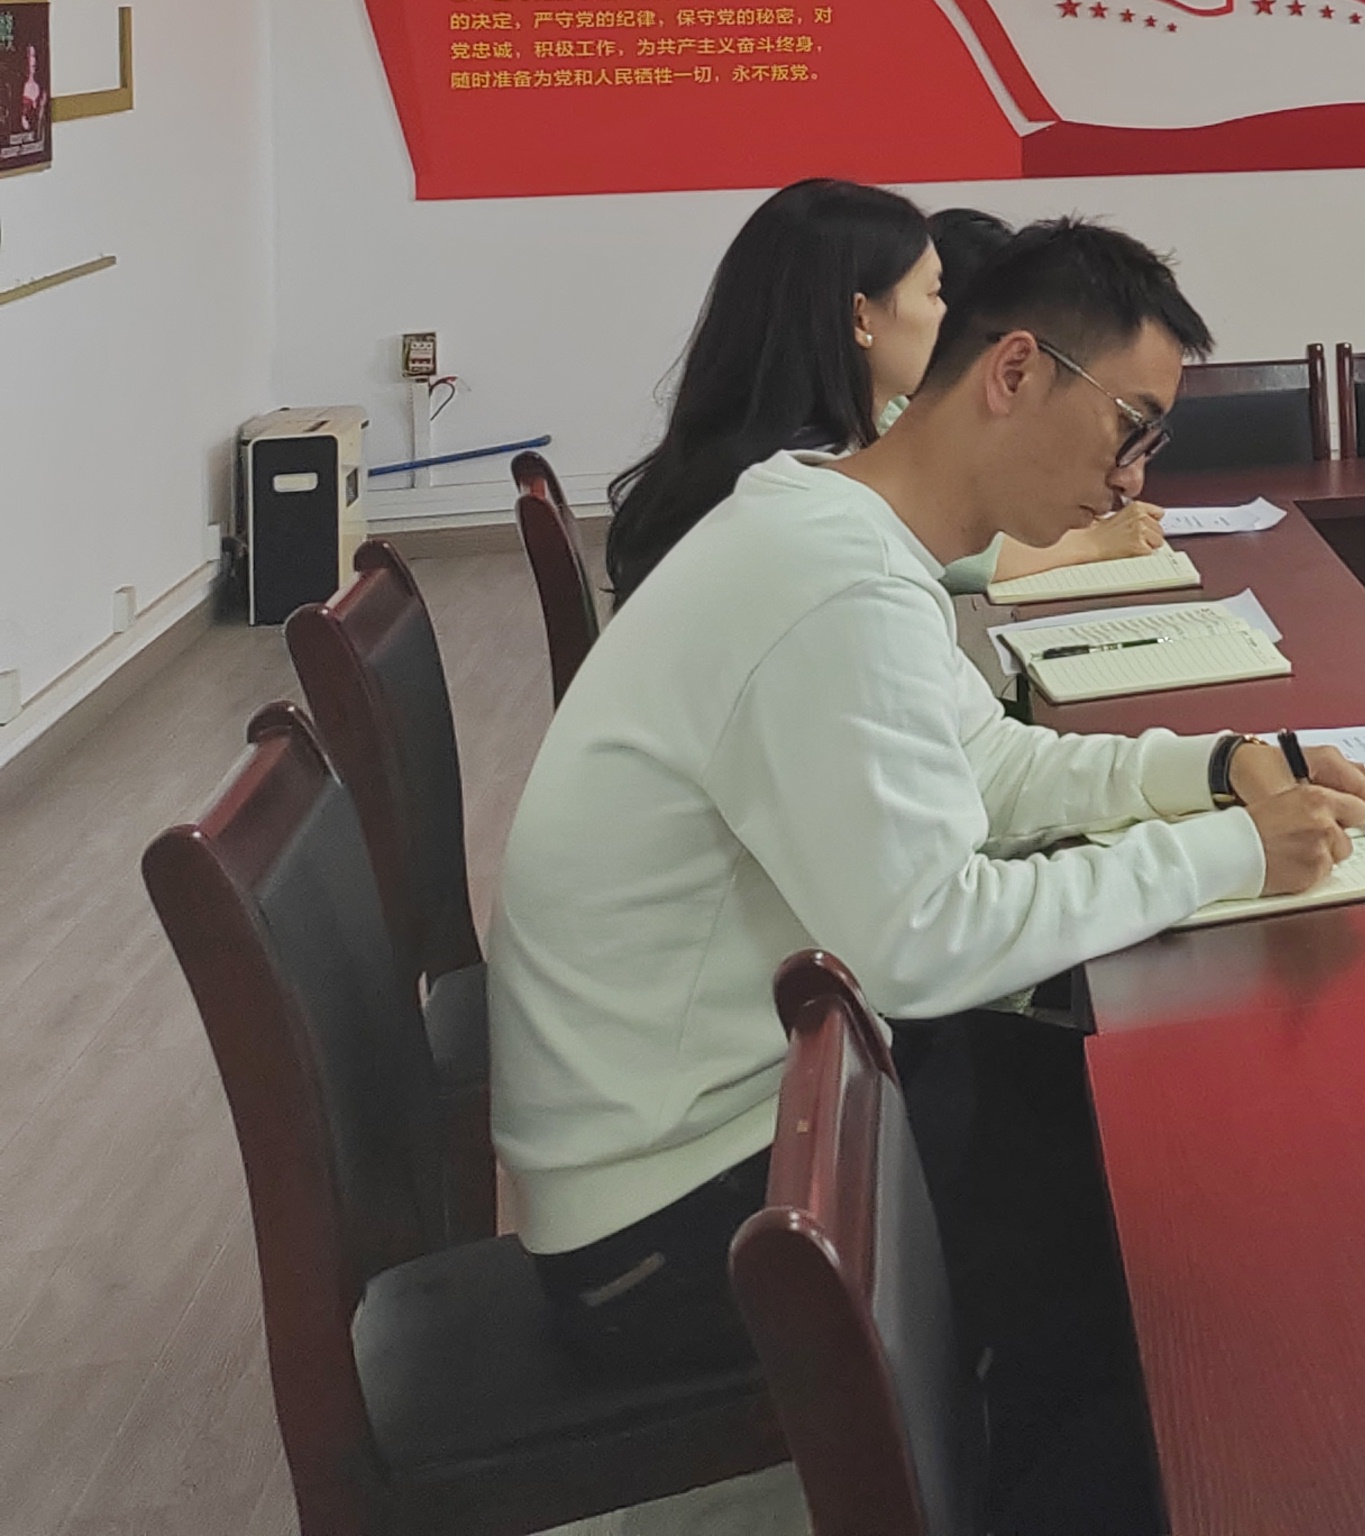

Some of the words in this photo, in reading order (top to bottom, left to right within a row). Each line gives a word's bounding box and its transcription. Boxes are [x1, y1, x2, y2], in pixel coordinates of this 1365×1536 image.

[450, 8, 832, 31] 的决定，严守党的纪律，保守党的秘密，对
[450, 64, 820, 90] 随时准备为党和人民牺牲一切，永不叛党。
